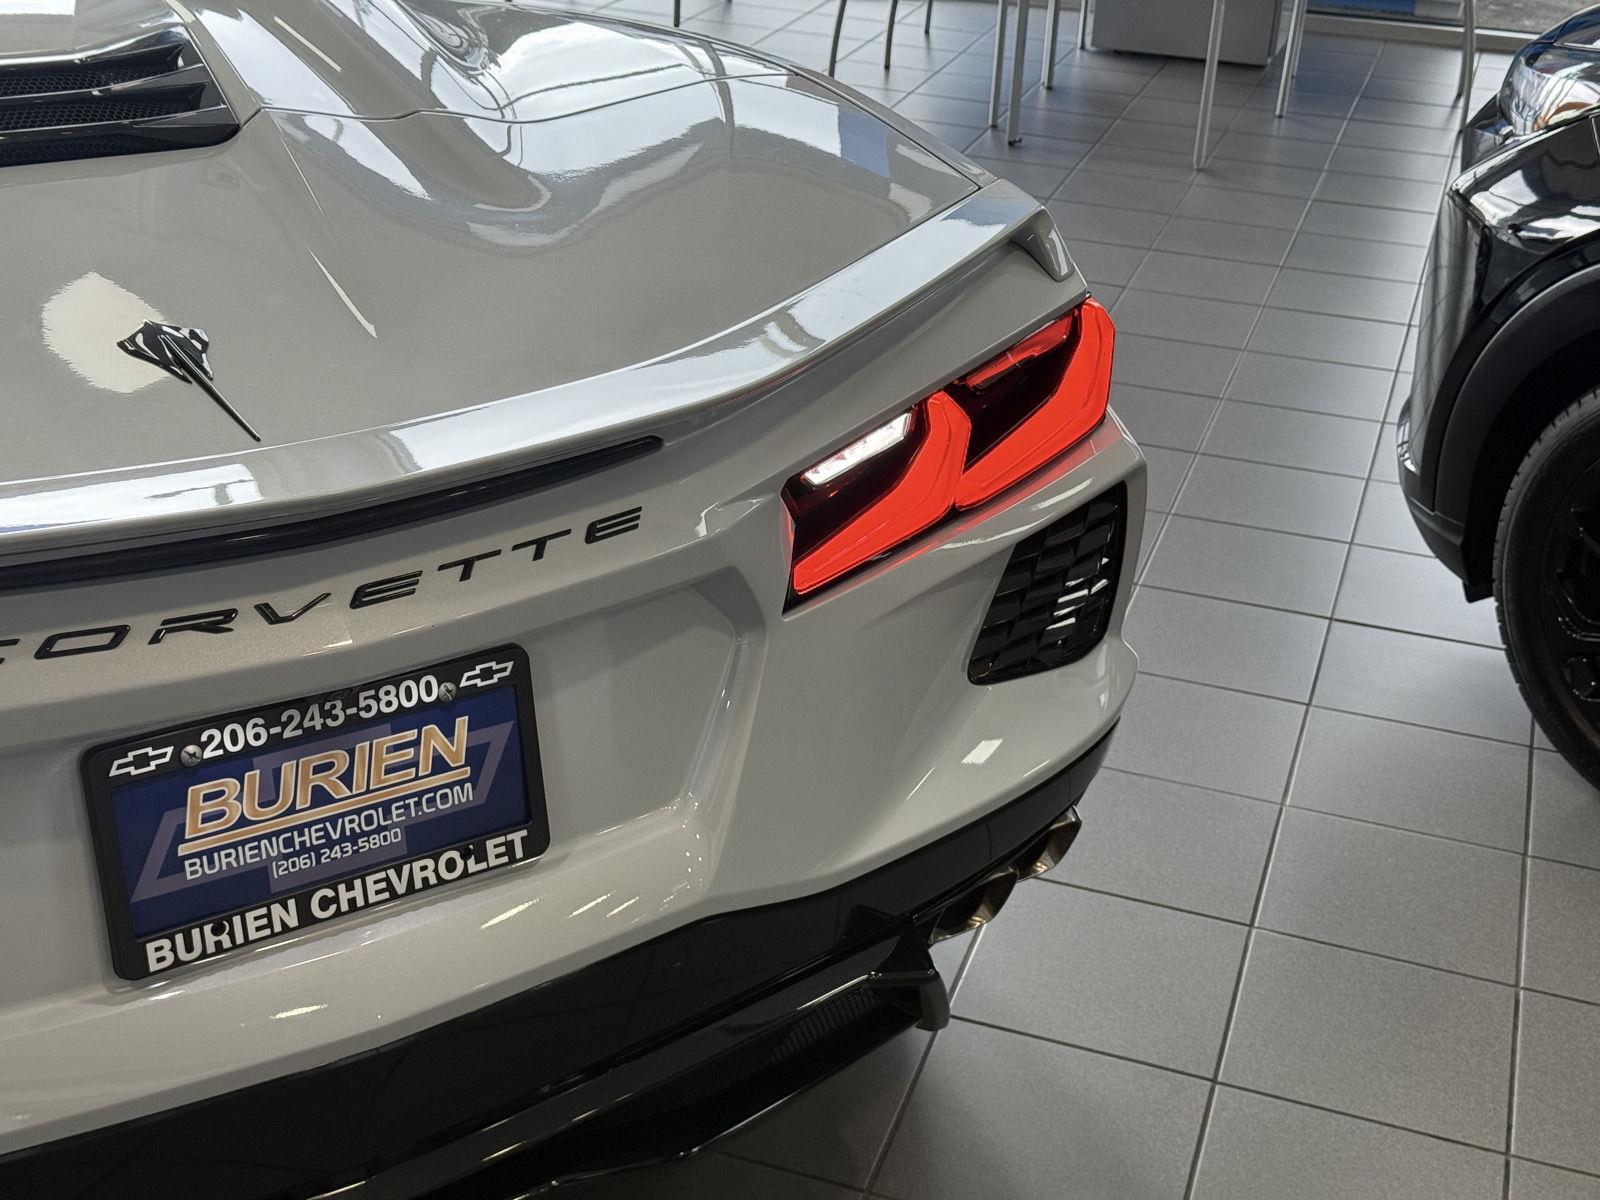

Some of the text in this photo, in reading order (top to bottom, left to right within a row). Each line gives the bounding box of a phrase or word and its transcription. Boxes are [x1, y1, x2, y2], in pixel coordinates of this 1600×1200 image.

[0, 505, 643, 664] ORVETTE
[200, 675, 440, 760] 206-243-5800
[184, 715, 469, 839] BURIEN
[184, 783, 474, 881] BURIENCHEVROLET.COM
[145, 829, 529, 973] BURIEN CHEVROLET
[272, 828, 402, 879] (206) 243-5800
